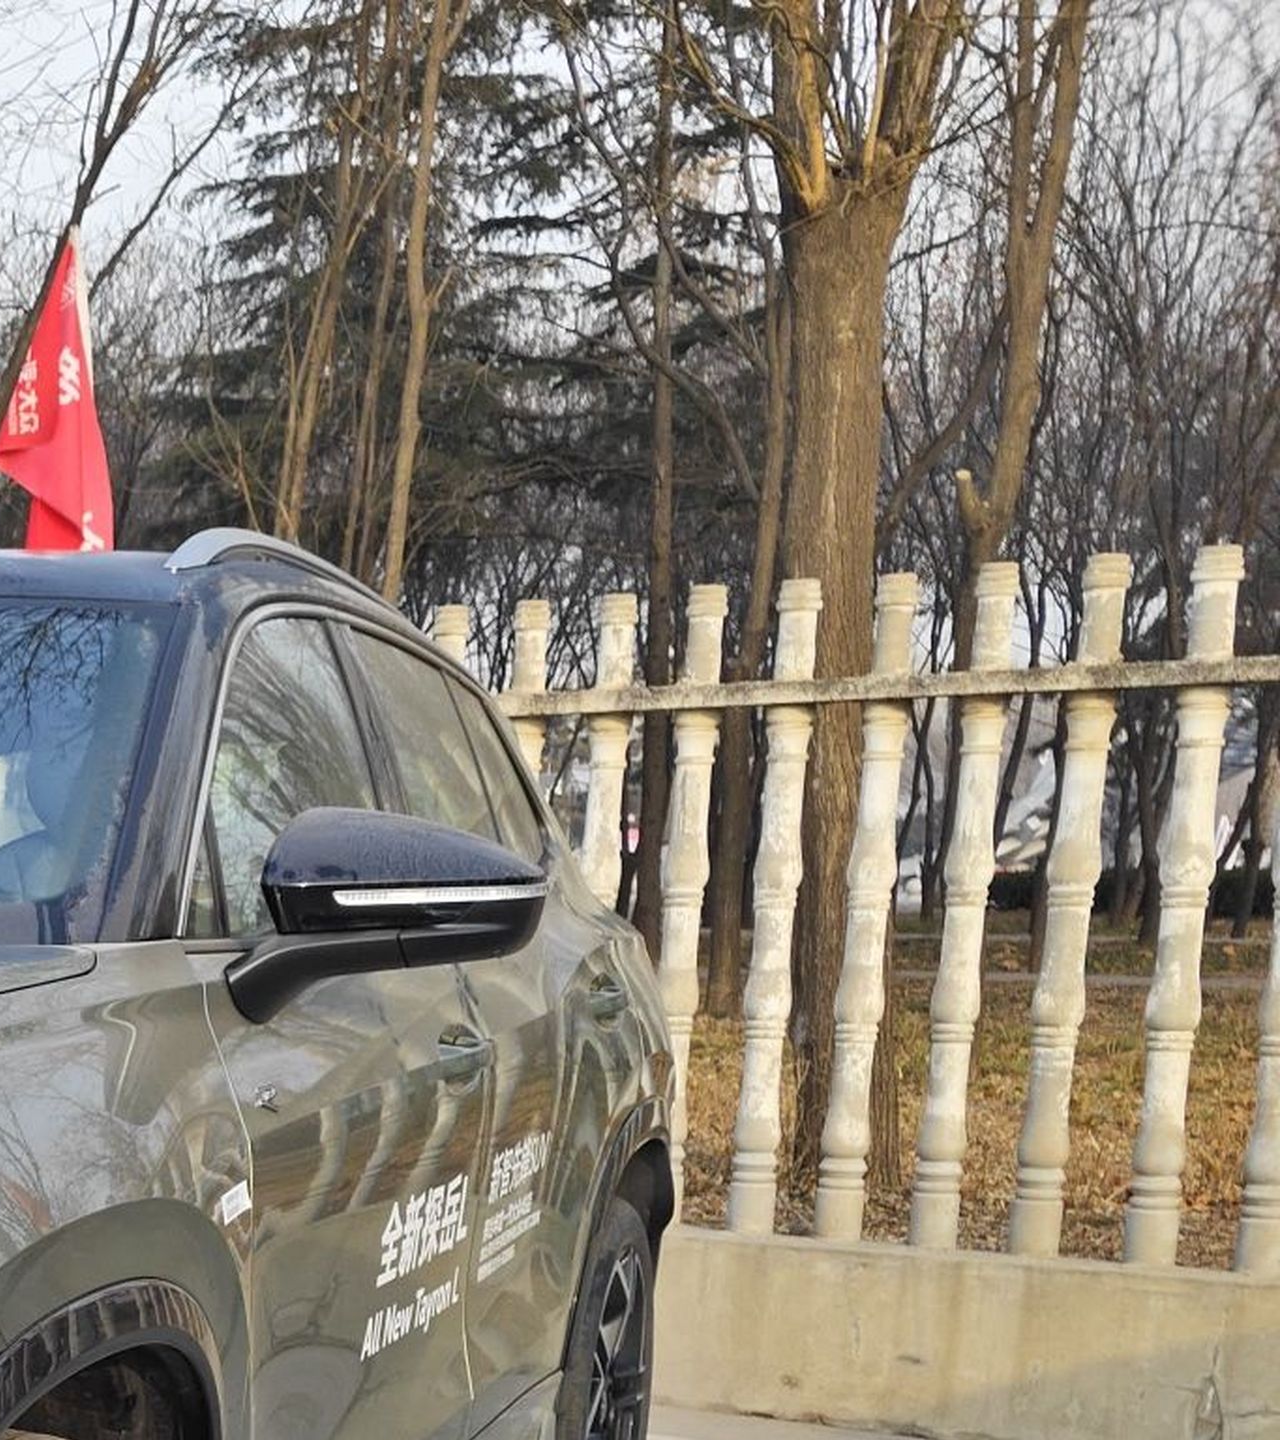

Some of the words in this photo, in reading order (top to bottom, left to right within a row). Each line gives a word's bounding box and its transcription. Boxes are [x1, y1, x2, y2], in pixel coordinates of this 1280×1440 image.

[361, 1309, 384, 1362] All
[382, 1303, 414, 1348] New
[415, 1279, 453, 1333] Tayron
